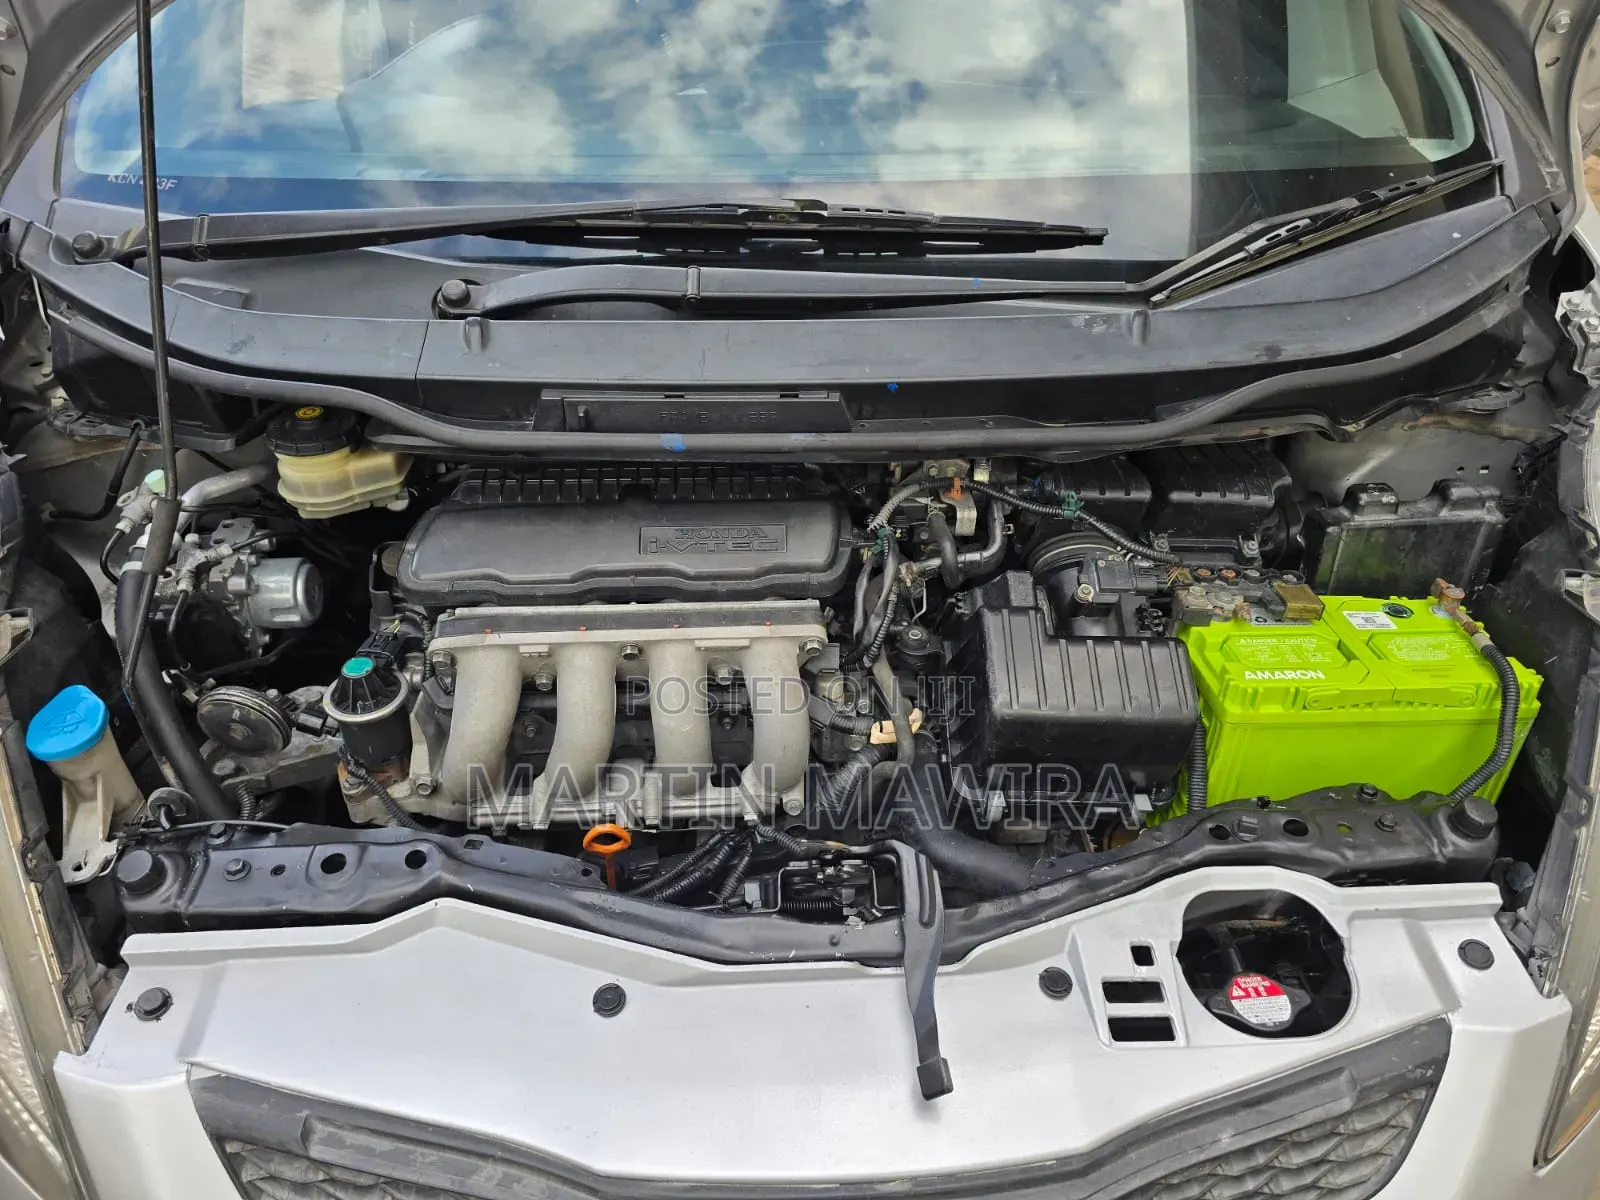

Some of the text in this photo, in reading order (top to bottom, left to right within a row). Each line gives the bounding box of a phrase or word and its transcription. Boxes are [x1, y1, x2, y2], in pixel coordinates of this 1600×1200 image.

[107, 173, 138, 184] KCN
[674, 527, 768, 540] HONDA
[1244, 669, 1326, 680] AMARON
